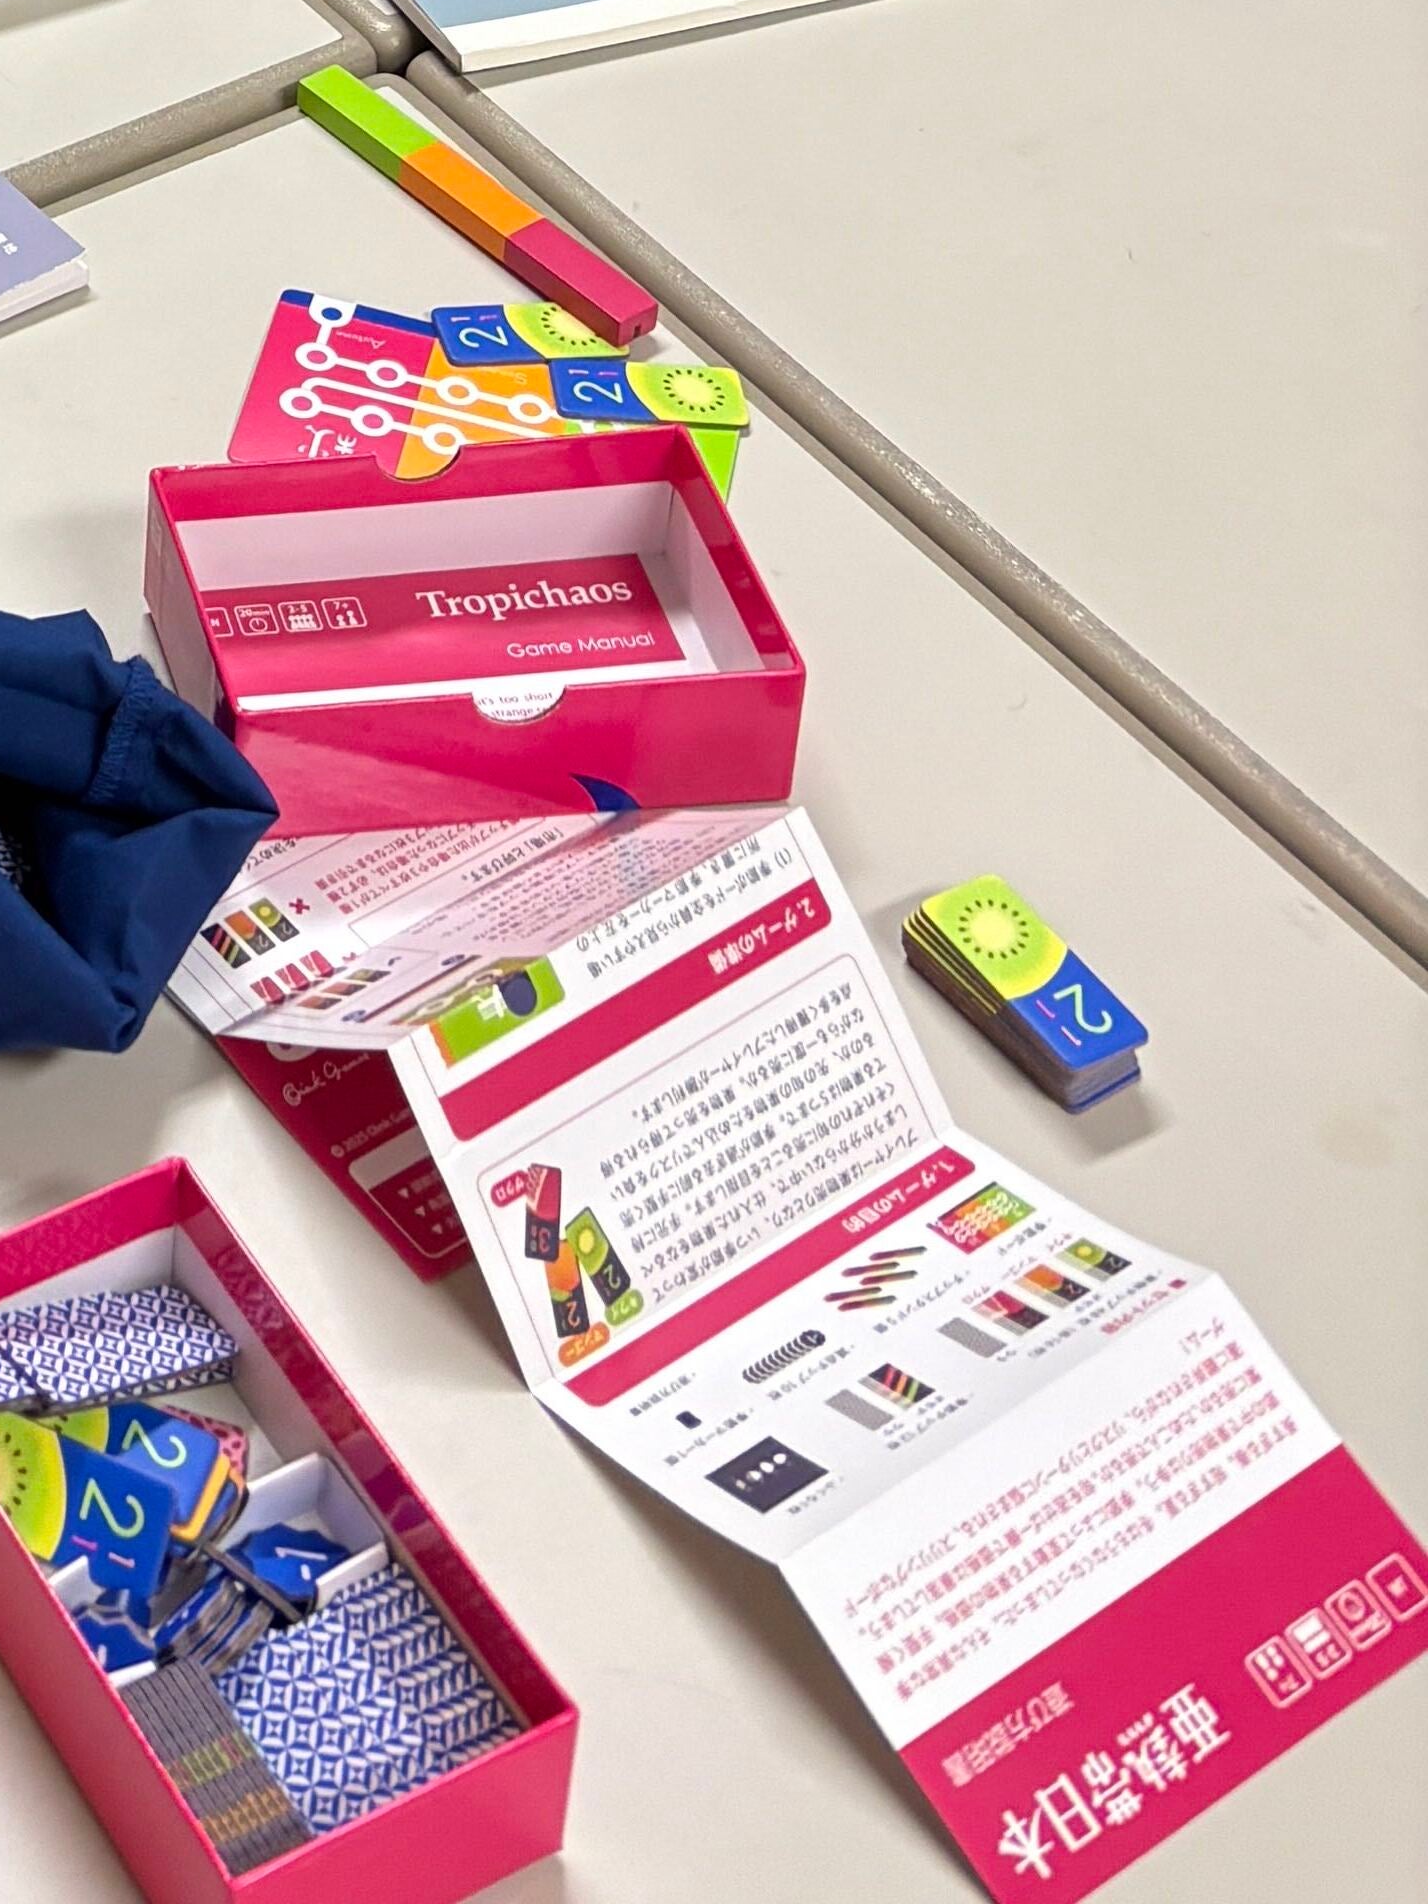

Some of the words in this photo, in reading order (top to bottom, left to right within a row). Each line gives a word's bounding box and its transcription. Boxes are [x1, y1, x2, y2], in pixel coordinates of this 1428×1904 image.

[457, 325, 509, 349] 2
[572, 381, 625, 405] 2
[416, 580, 633, 623] Tropichaos
[507, 639, 573, 660] Game
[578, 631, 656, 653] Manual
[705, 904, 800, 975] ゲームの準備
[1053, 982, 1113, 1035] 2
[121, 1419, 187, 1468] 2
[79, 1478, 145, 1538] 2
[937, 1675, 1077, 1791] 遊び方説明書
[981, 1677, 1233, 1893] 亜熱帯日本
